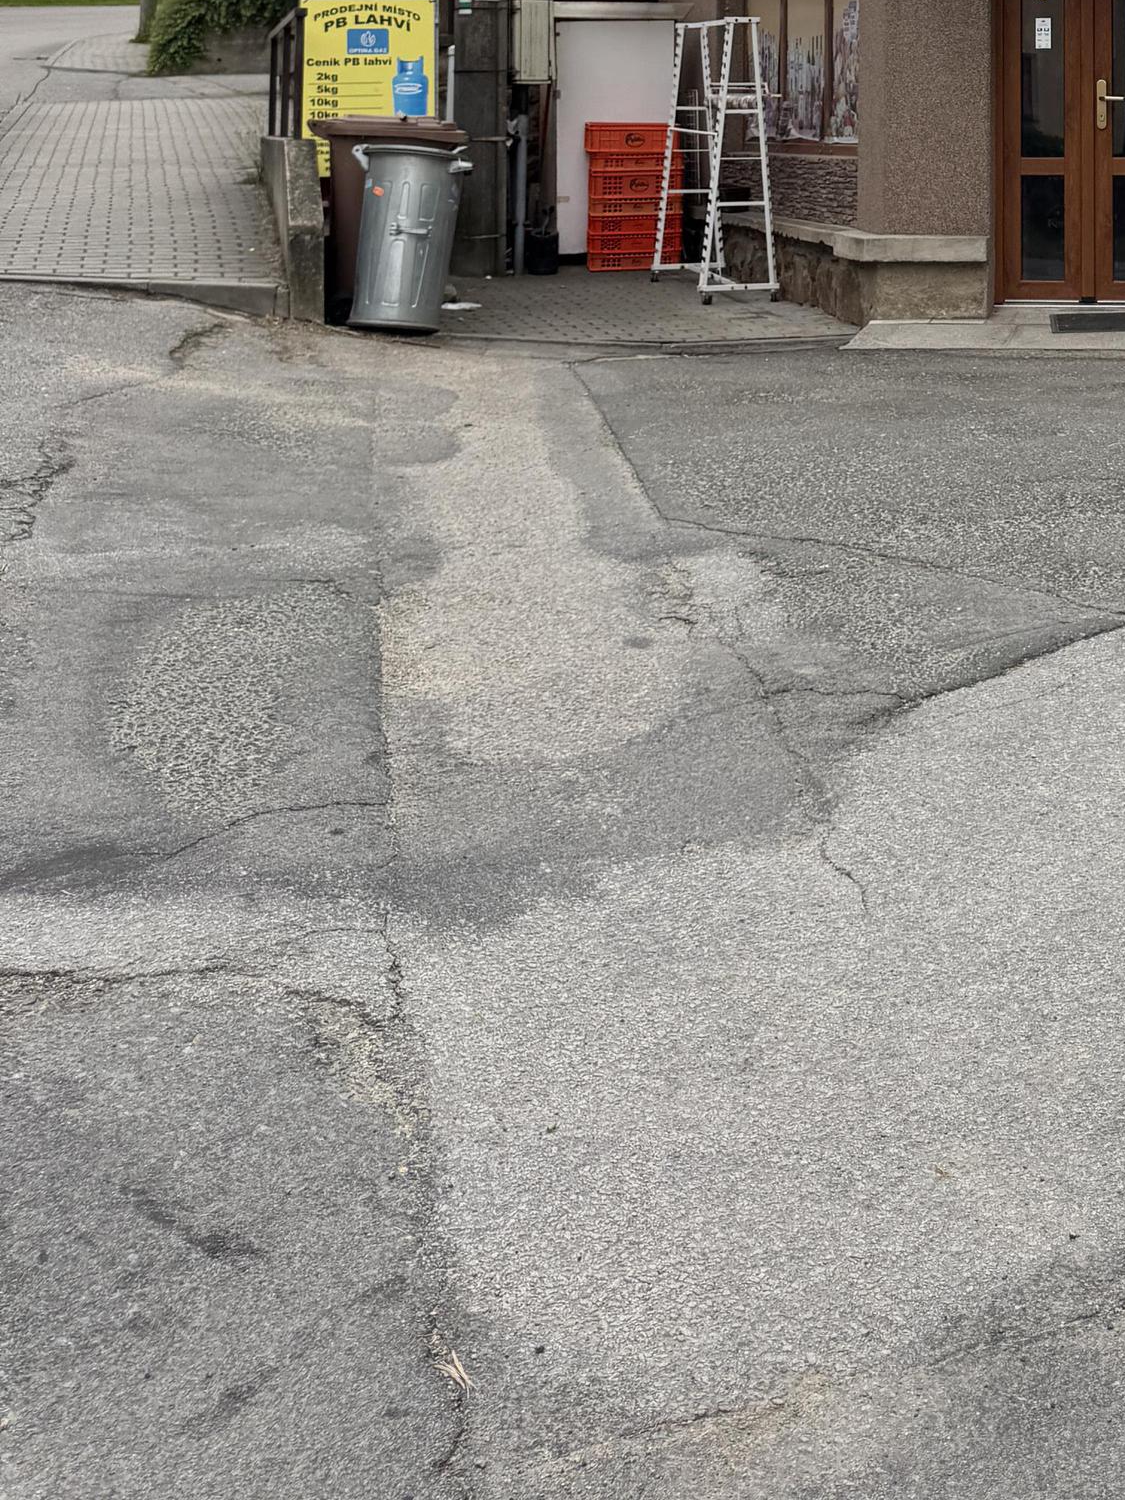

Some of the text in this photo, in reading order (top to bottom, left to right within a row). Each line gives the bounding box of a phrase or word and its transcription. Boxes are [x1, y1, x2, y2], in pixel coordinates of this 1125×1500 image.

[313, 3, 421, 21] PRODEJNÍ MÍSTO
[324, 14, 411, 32] PB LAHVÍ
[344, 57, 360, 67] PB
[316, 72, 338, 82] 2kg
[316, 85, 338, 94] 5kg
[310, 98, 338, 107] 10kg
